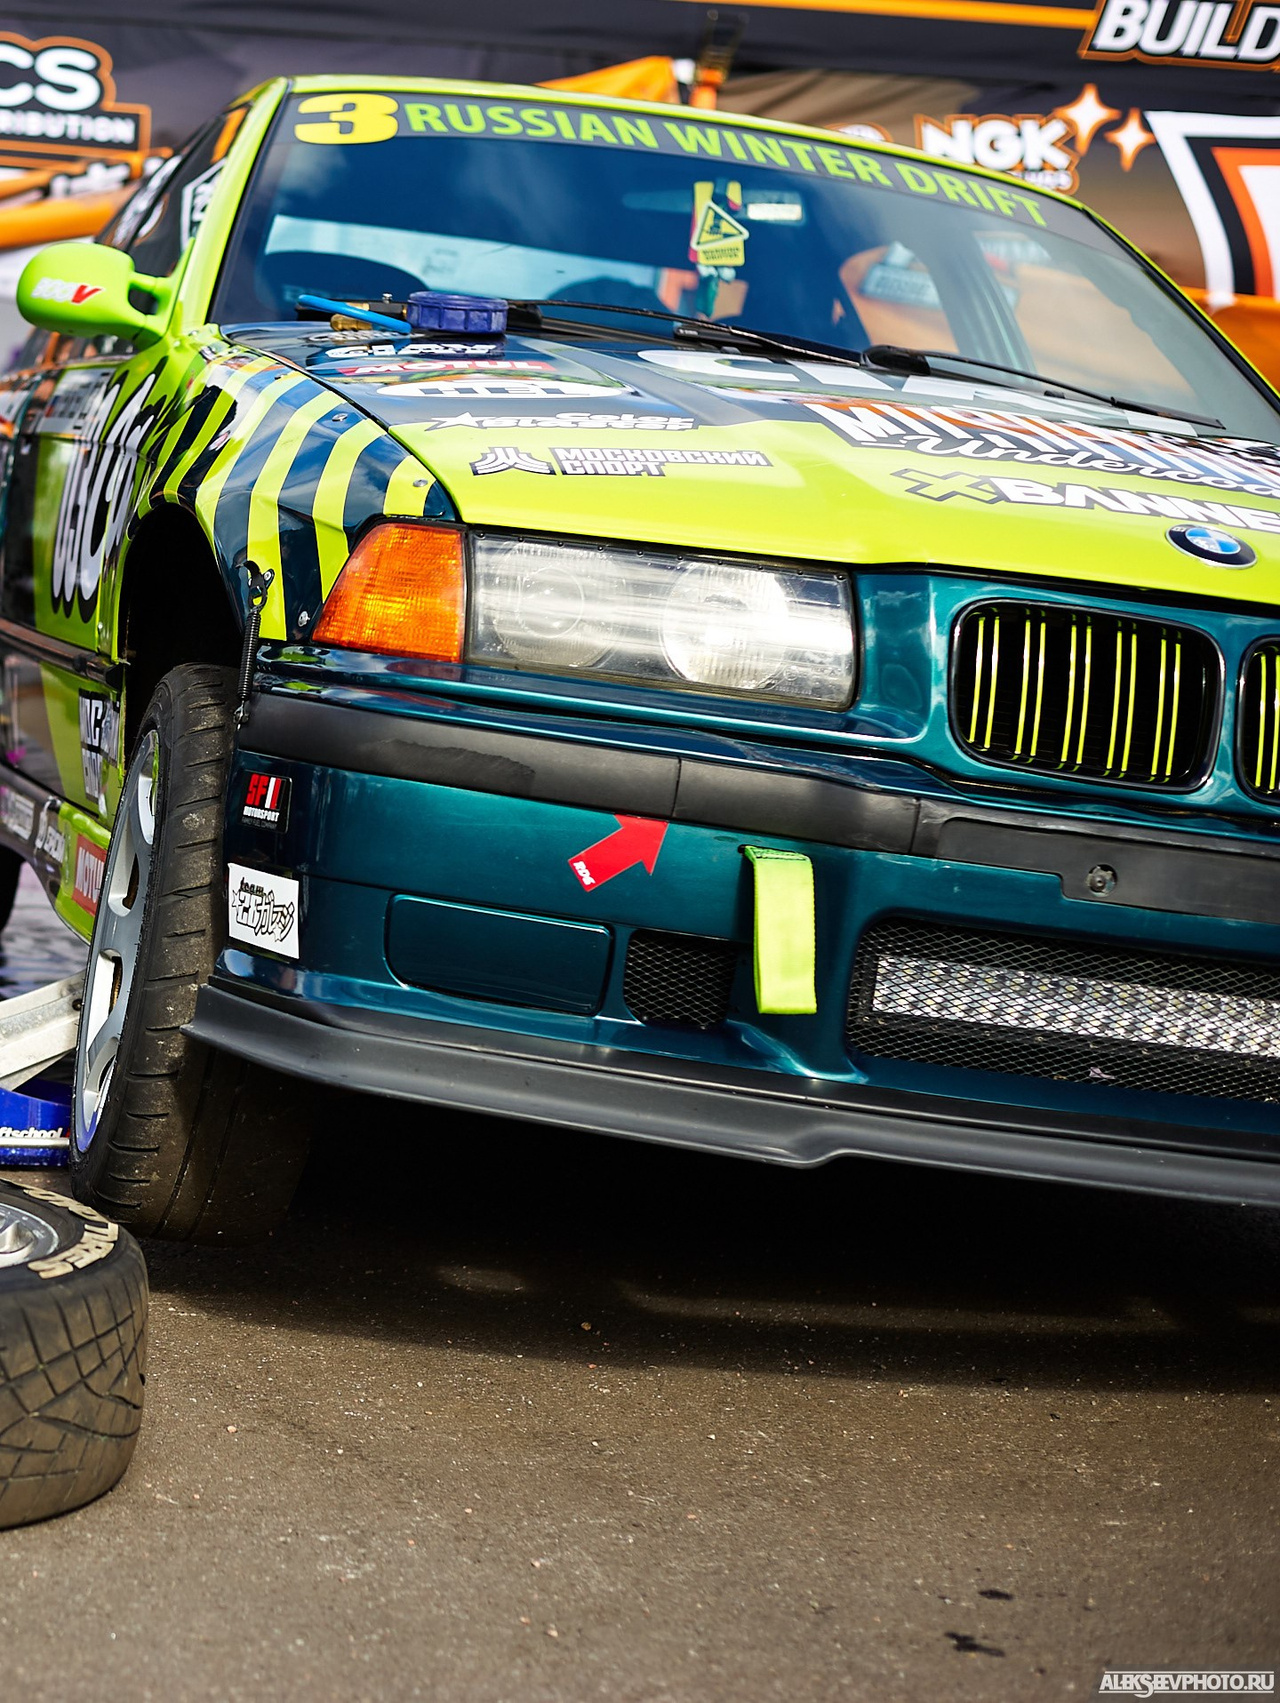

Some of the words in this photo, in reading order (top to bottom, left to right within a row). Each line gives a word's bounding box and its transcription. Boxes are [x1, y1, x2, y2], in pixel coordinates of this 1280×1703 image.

[294, 93, 399, 145] 3
[922, 118, 1072, 171] NGK
[404, 102, 660, 149] RUSSIAN
[662, 121, 893, 187] WINTER
[895, 161, 1048, 228] DRIFT
[354, 360, 546, 374] MOTUL
[418, 384, 591, 397] HEL
[554, 447, 770, 466] МОСКОВСКИЙ
[559, 460, 663, 476] СПОРТ
[989, 478, 1280, 535] BANNE
